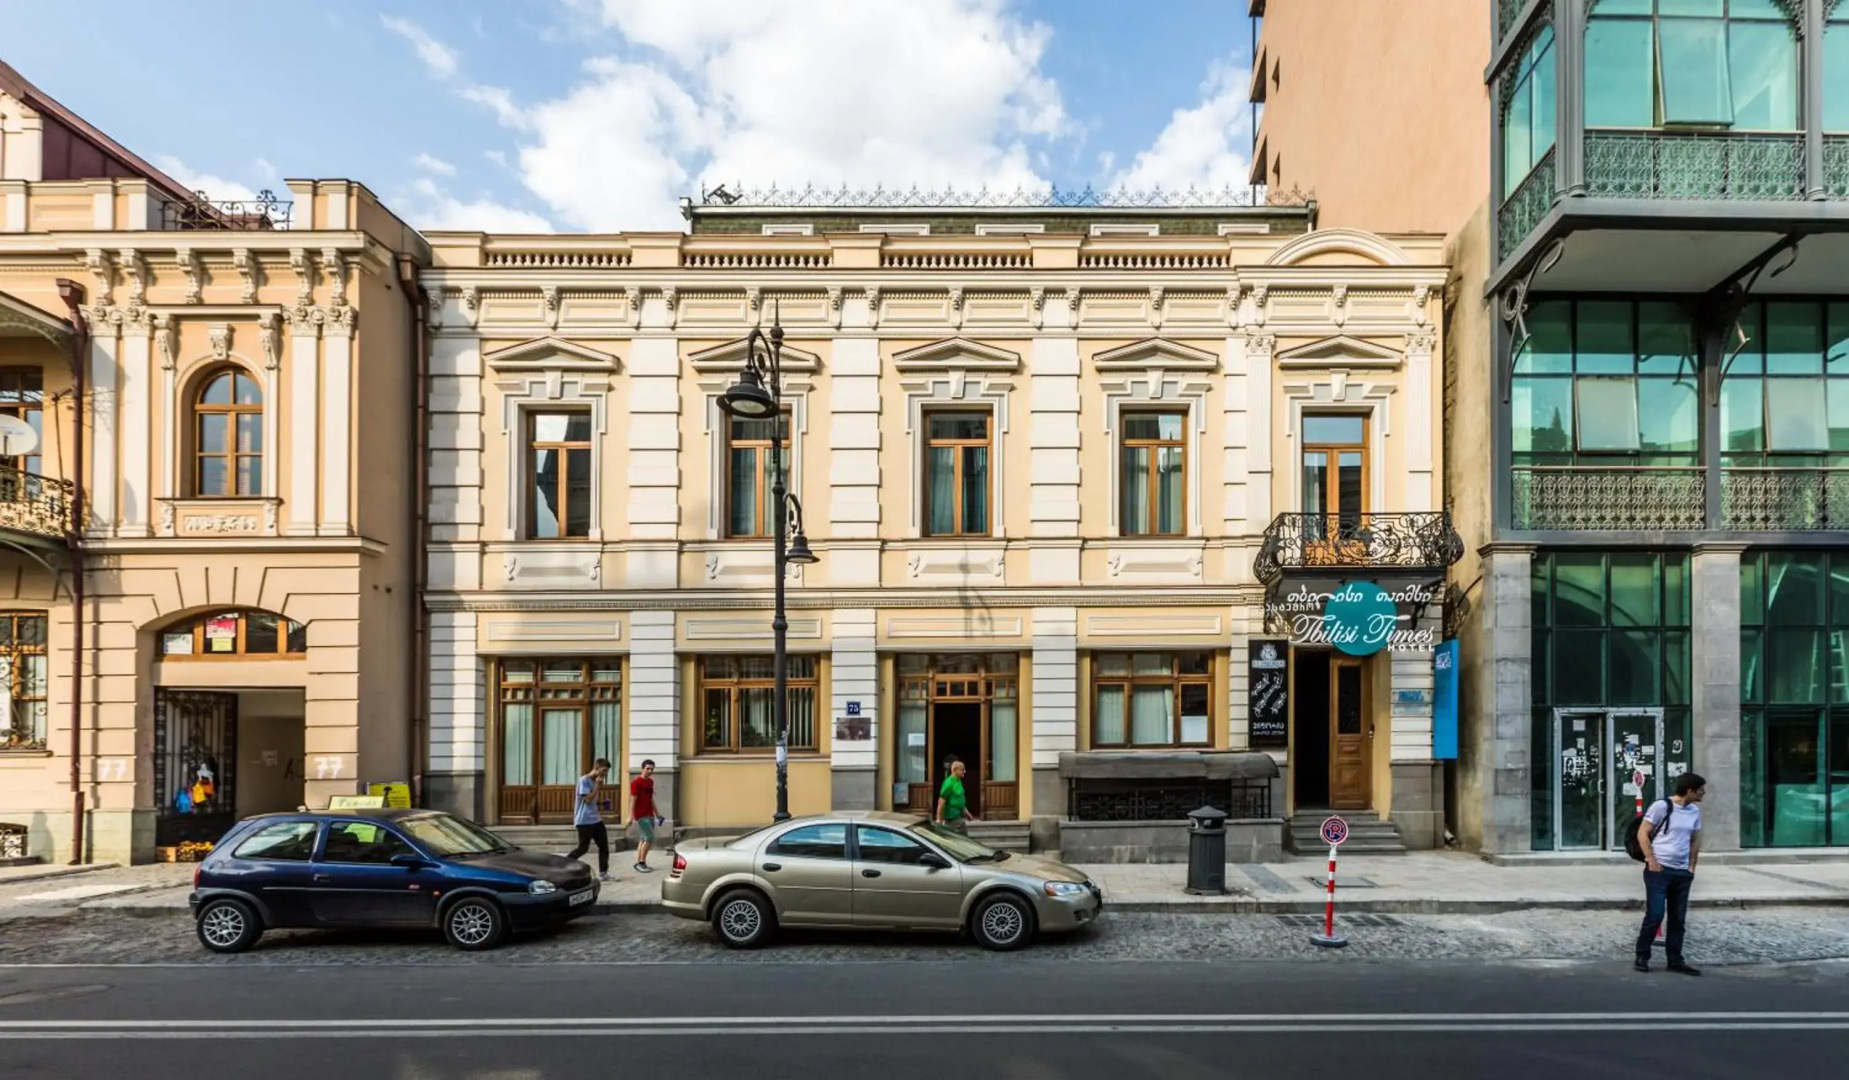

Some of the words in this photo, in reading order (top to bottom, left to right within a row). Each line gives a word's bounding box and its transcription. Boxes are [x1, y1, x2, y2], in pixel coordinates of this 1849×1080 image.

[1287, 584, 1363, 609] თბილისი
[1376, 584, 1432, 602] თაიმსი
[1289, 613, 1359, 644] Tbilisi
[1363, 613, 1433, 644] Times
[1387, 644, 1435, 652] HOTEL
[848, 703, 859, 712] 75
[97, 759, 126, 781] 77
[314, 757, 343, 779] 77
